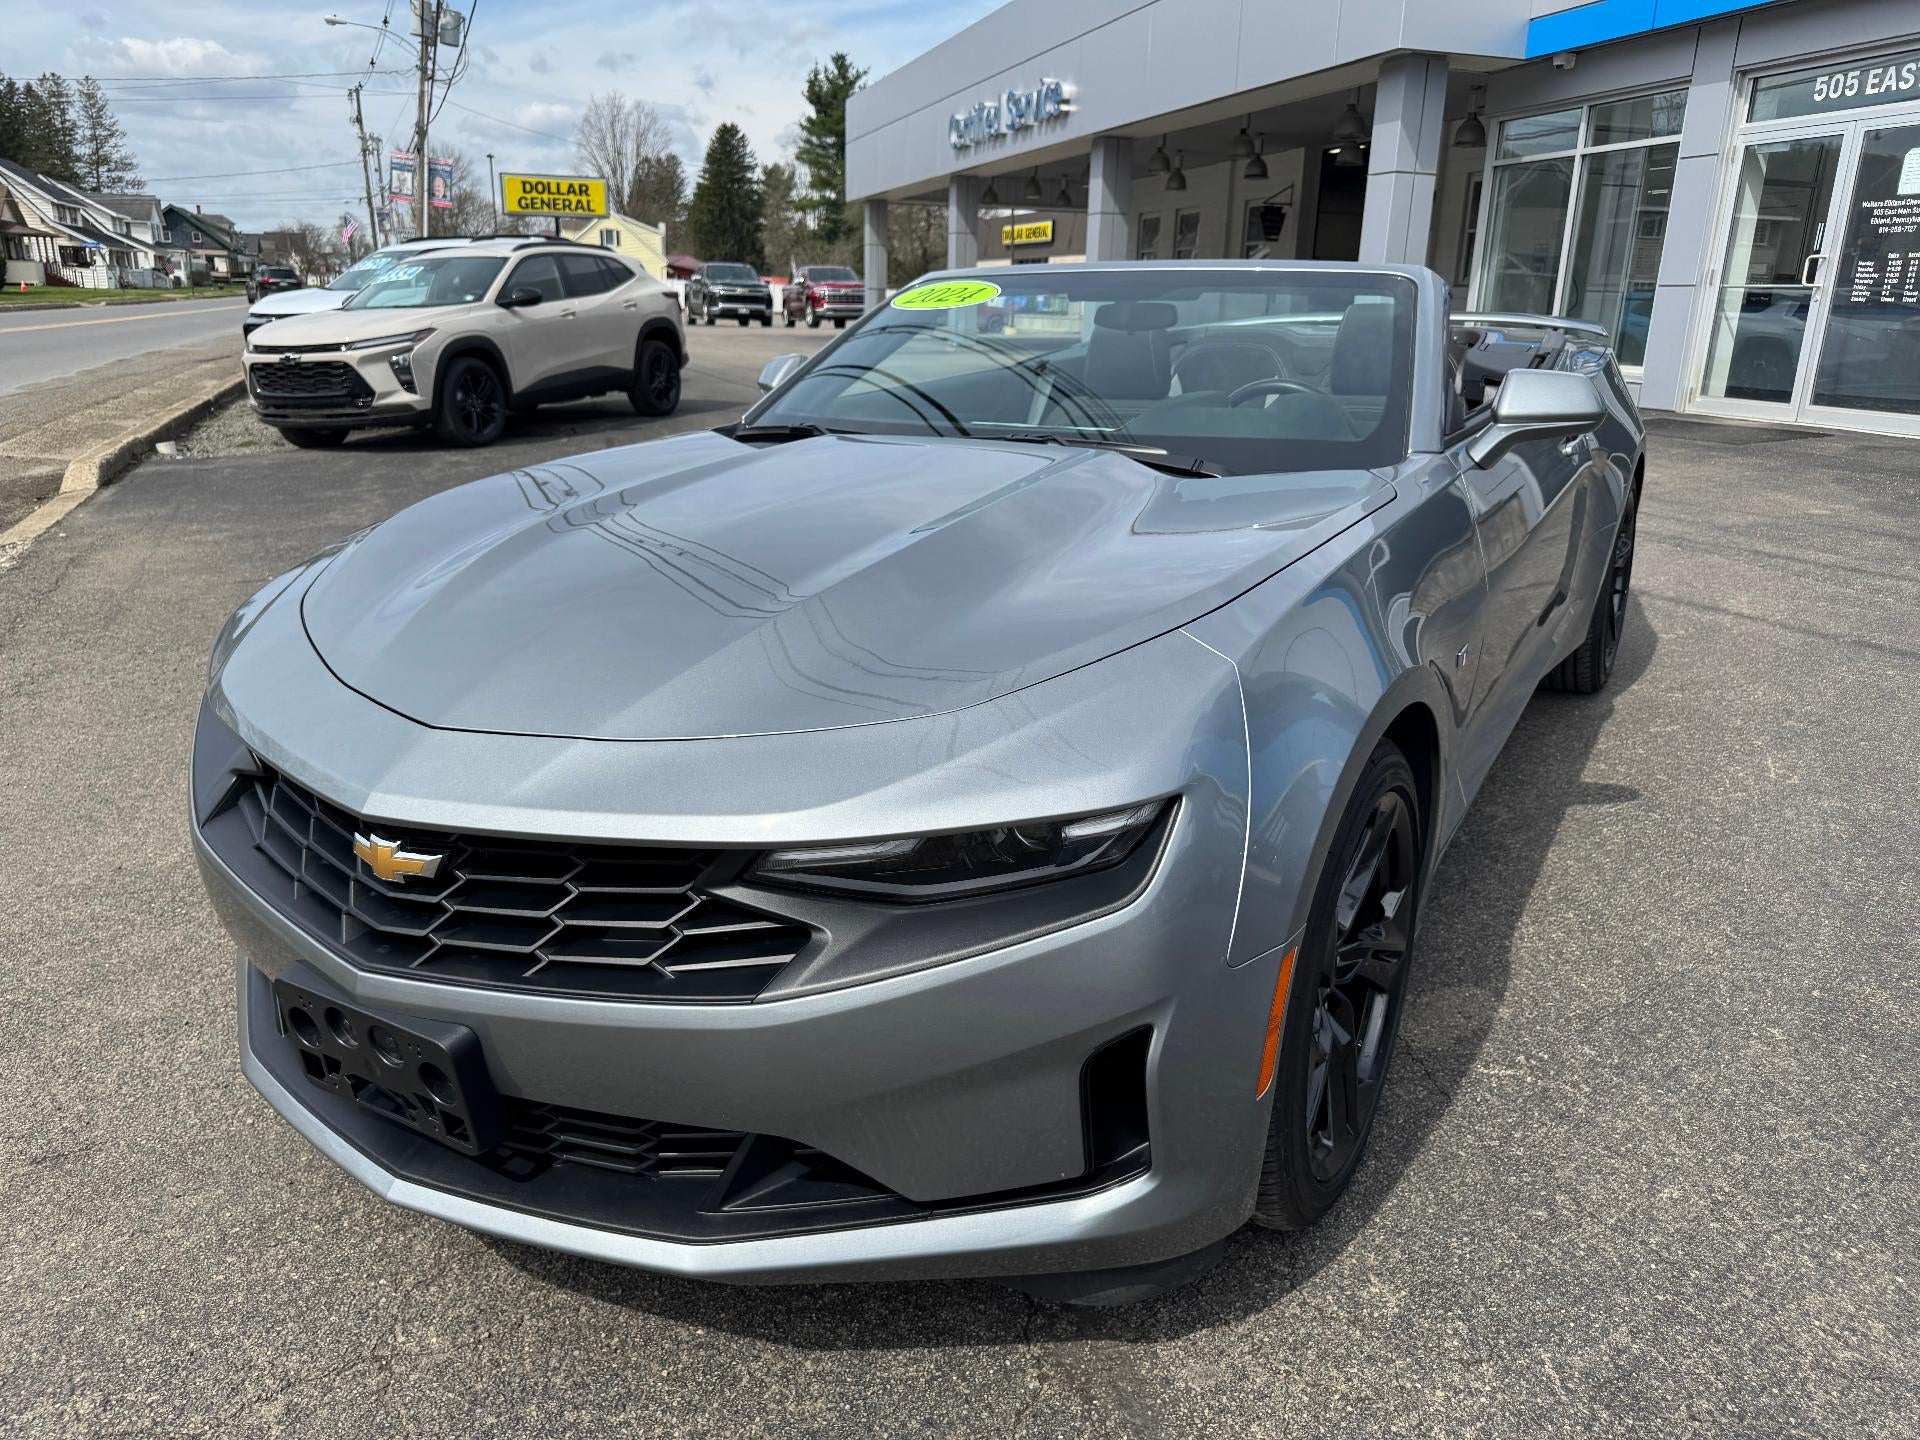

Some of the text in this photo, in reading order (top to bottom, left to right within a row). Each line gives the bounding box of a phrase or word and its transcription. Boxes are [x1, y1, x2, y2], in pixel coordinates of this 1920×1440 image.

[1813, 61, 1920, 102] 505 EAS
[949, 77, 1069, 149] Certified Service
[521, 180, 590, 197] DOLLAR
[518, 196, 596, 212] GENERAL
[1002, 228, 1024, 242] DOLAR
[902, 287, 988, 305] 2024
